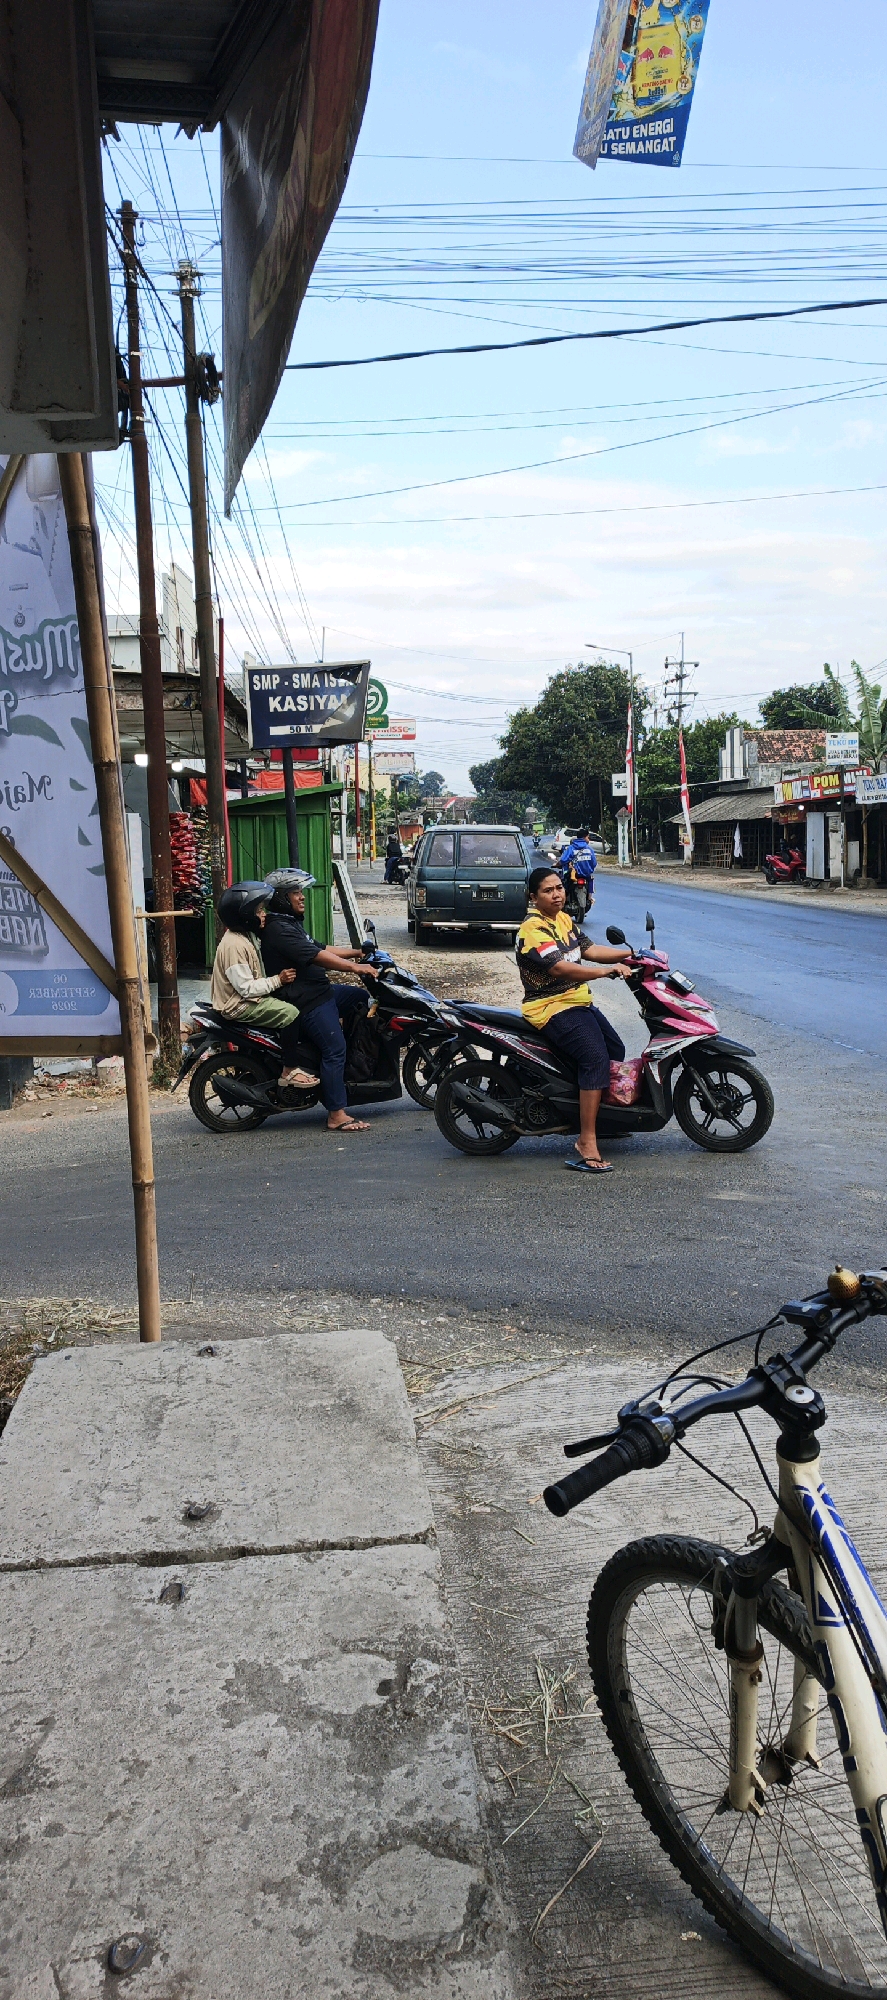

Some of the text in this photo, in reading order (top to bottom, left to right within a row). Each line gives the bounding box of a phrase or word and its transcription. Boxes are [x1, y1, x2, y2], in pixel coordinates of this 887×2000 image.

[632, 117, 674, 138] ENERGI
[610, 136, 677, 155] SEMANGAT
[252, 674, 280, 691] SMP
[292, 672, 321, 688] SMA
[289, 725, 313, 734] 50 M
[813, 773, 840, 788] POM
